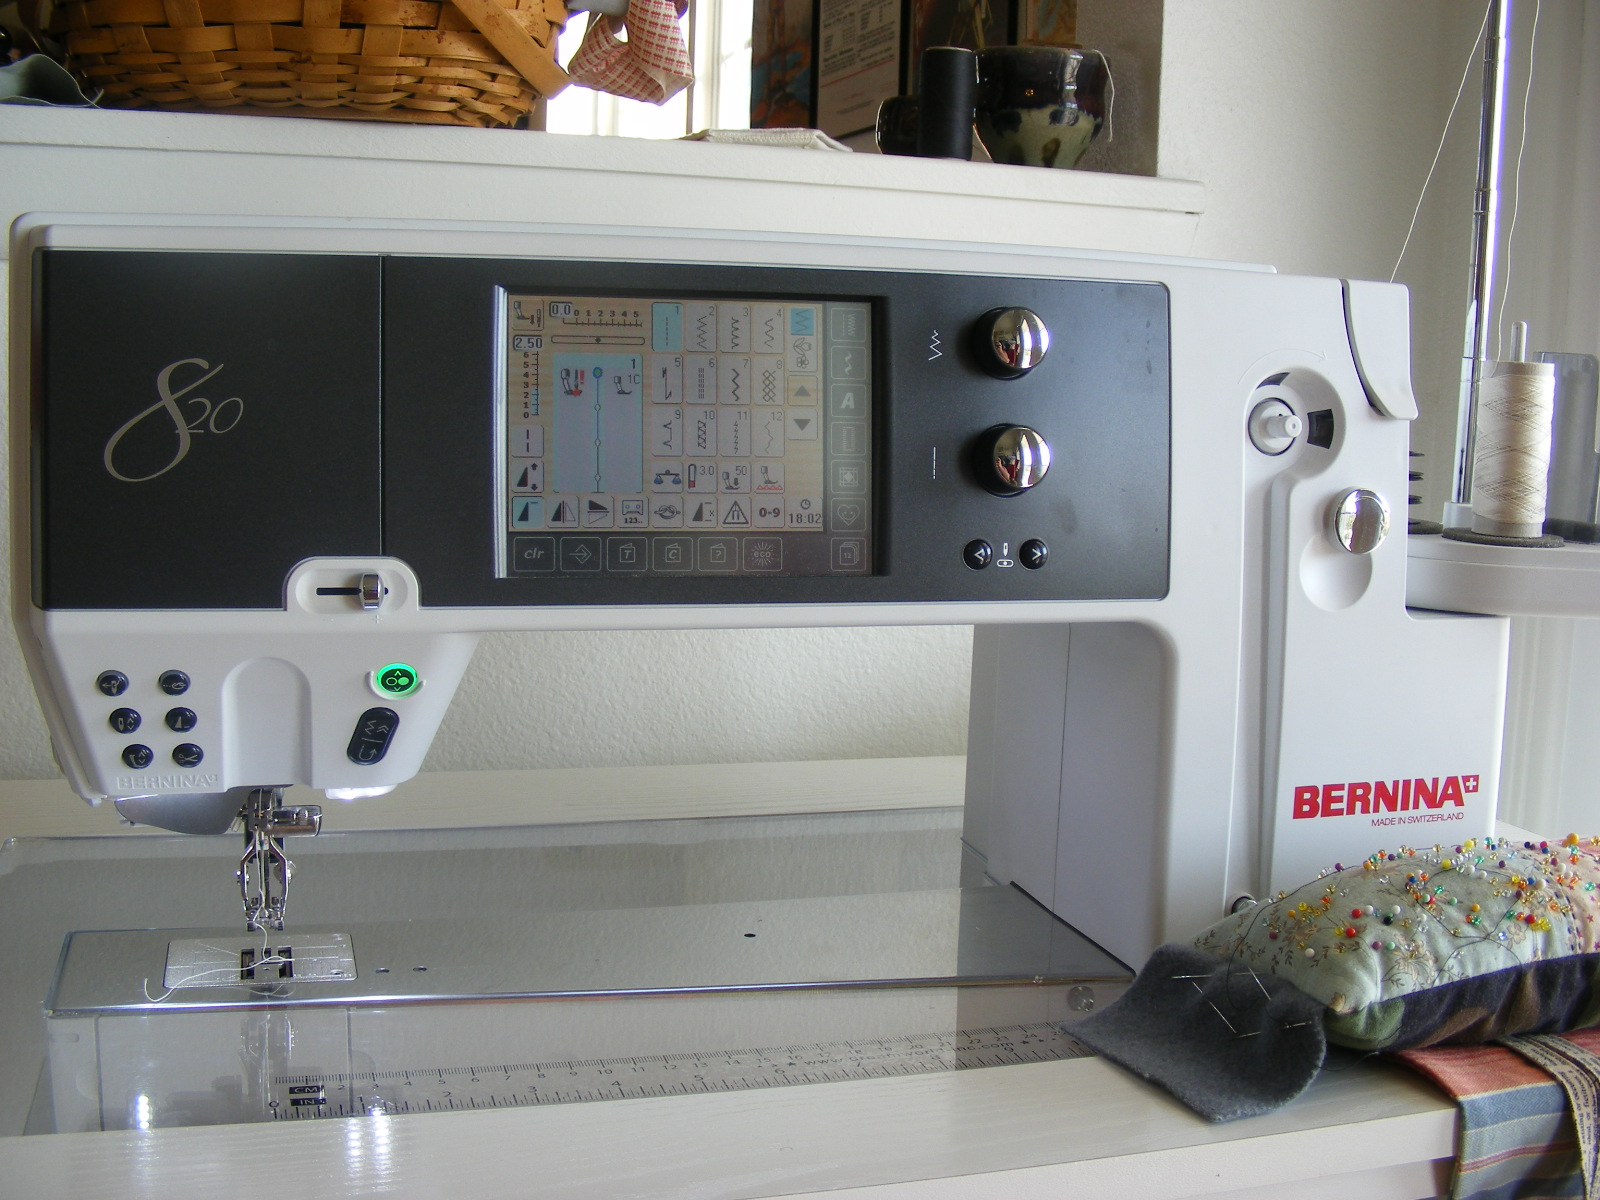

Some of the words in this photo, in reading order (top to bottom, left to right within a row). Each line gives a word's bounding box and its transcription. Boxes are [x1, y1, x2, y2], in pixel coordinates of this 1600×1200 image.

[551, 304, 571, 316] 0.0
[674, 306, 680, 315] 1
[708, 307, 715, 316] 2
[743, 307, 749, 317] 3
[776, 308, 782, 317] 4
[515, 337, 543, 349] 2.50
[674, 357, 681, 367] 5
[708, 358, 715, 368] 6
[743, 359, 749, 368] 7
[776, 360, 783, 369] 8
[628, 374, 641, 385] 1C
[104, 358, 244, 482] 820
[674, 409, 681, 420] 9
[703, 410, 715, 420] 10
[737, 411, 748, 420] 11
[771, 411, 783, 421] 12
[699, 465, 715, 476] 3.0
[735, 465, 748, 476] 50
[758, 507, 781, 518] 0-9
[789, 513, 822, 524] 18:02
[523, 547, 545, 559] clr
[116, 774, 209, 790] BERNINA
[1292, 775, 1465, 820] BERNINA
[1371, 817, 1397, 827] MADE
[1397, 816, 1406, 825] IN
[1407, 812, 1465, 824] SWITZERLAND
